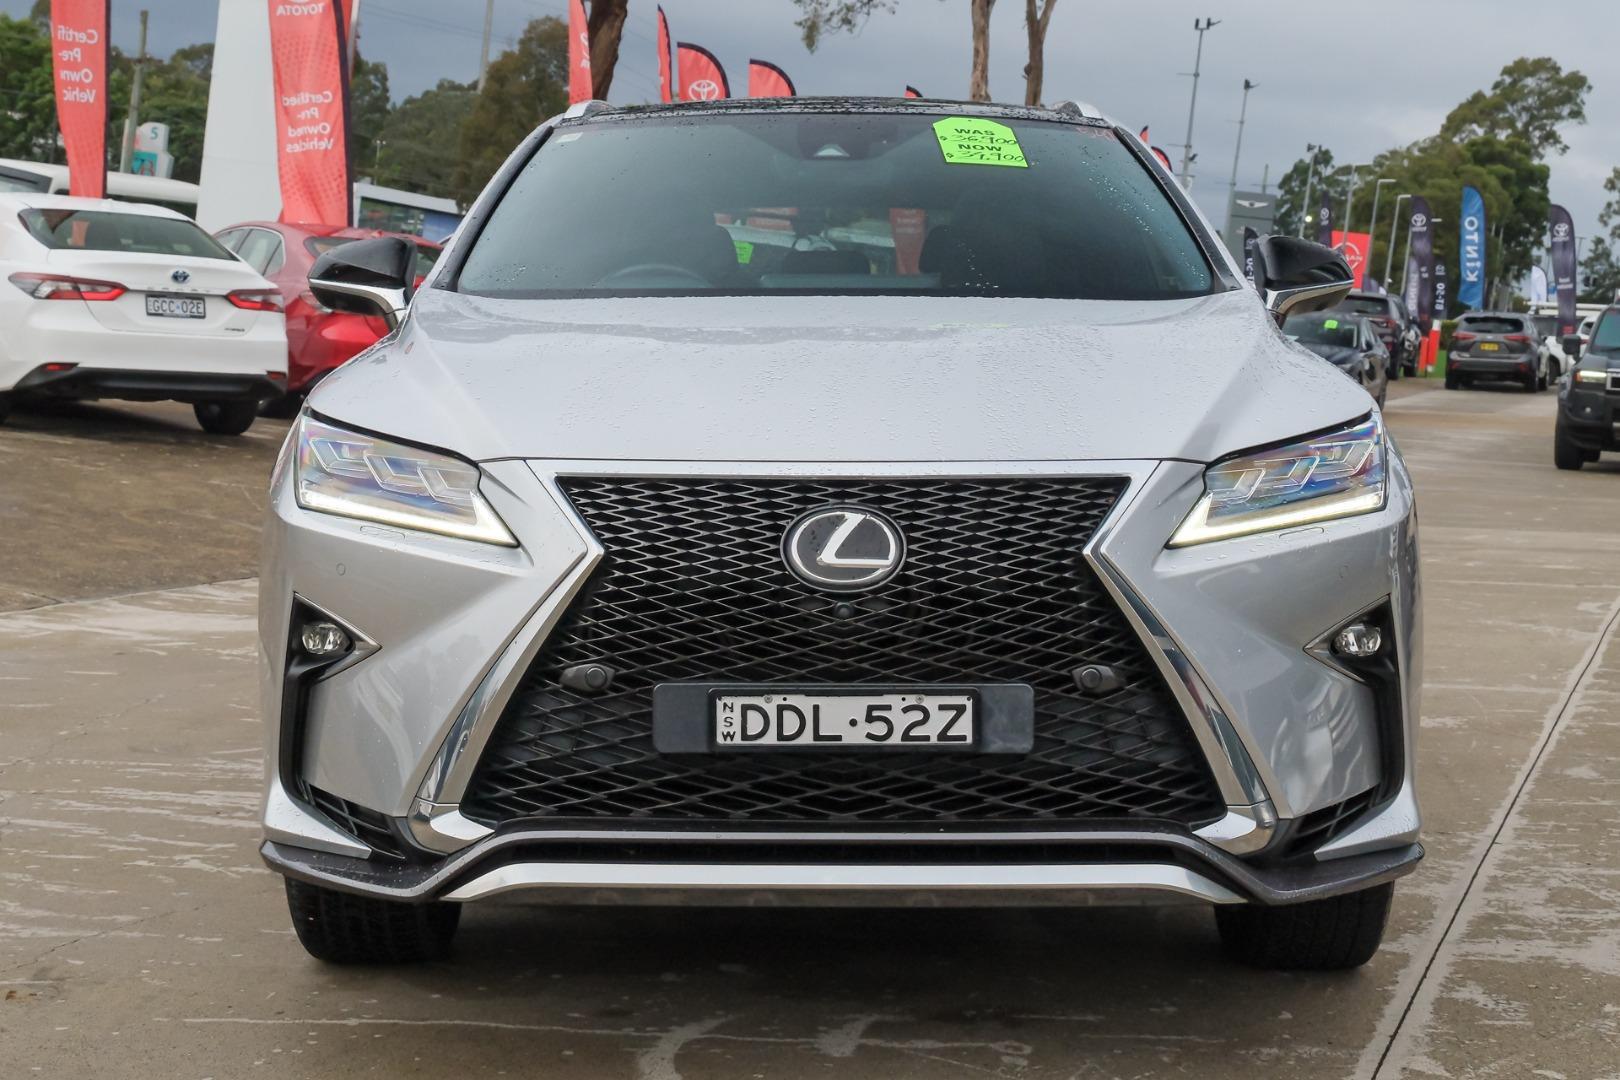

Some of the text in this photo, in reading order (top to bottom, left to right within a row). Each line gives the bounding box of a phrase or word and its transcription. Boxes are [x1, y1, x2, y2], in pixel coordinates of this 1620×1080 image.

[954, 128, 995, 136] WAS
[958, 143, 1002, 152] NOW
[722, 702, 736, 742] NSW
